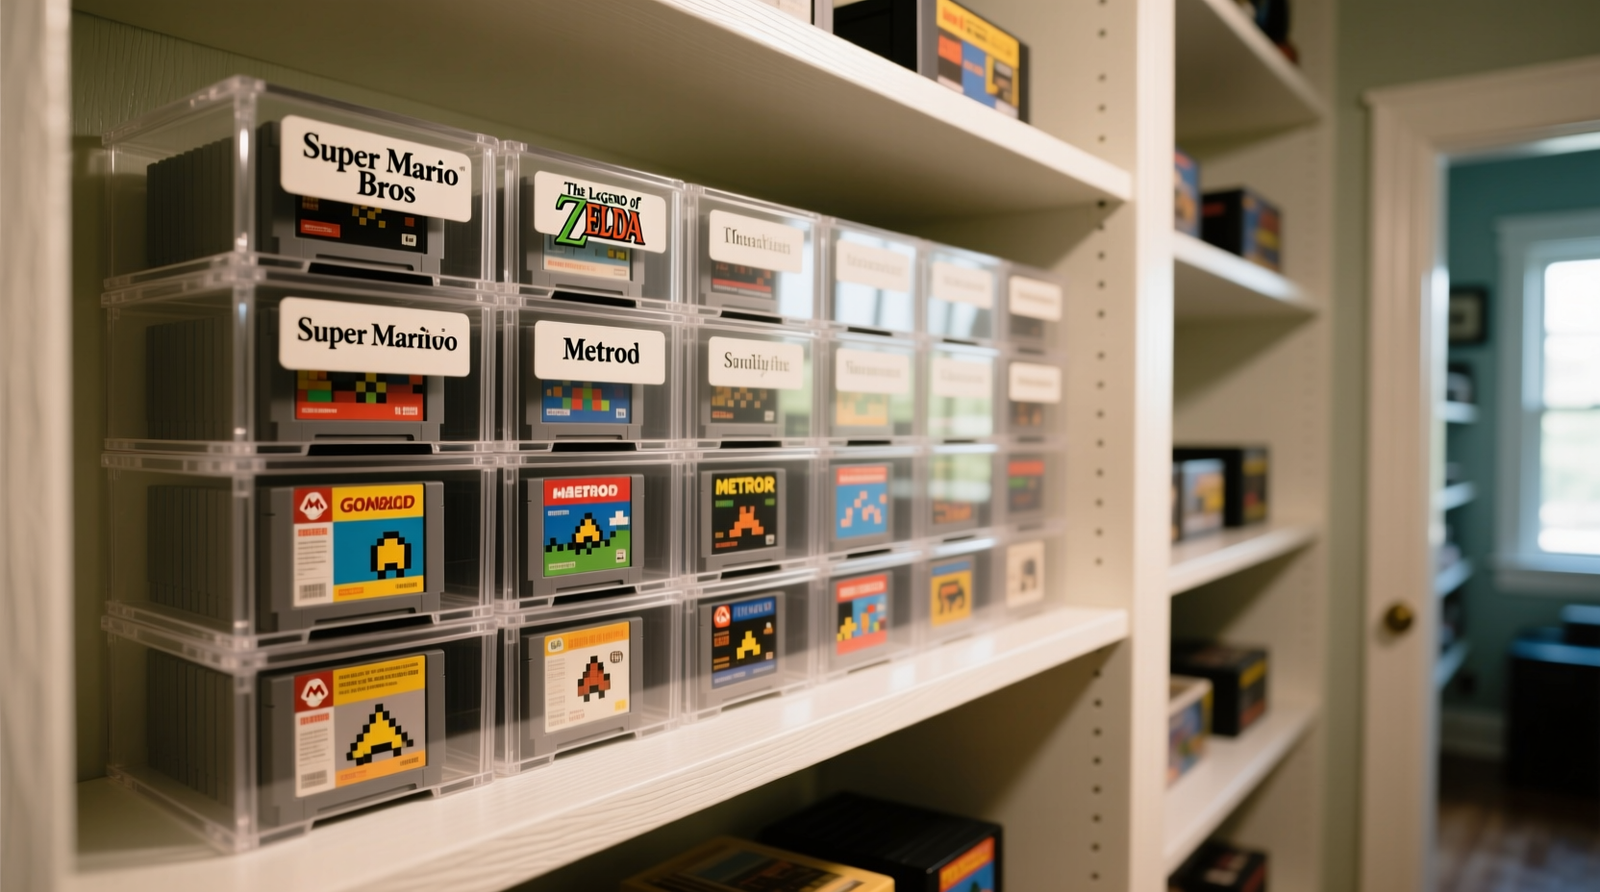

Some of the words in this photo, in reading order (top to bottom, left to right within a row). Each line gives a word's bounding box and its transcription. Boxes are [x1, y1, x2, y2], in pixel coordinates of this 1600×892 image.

[303, 132, 380, 172] Super
[386, 148, 459, 186] Mario
[357, 170, 416, 203] Bros
[554, 193, 646, 248] ZELDA
[297, 316, 367, 349] Super
[562, 337, 640, 364] Metrod
